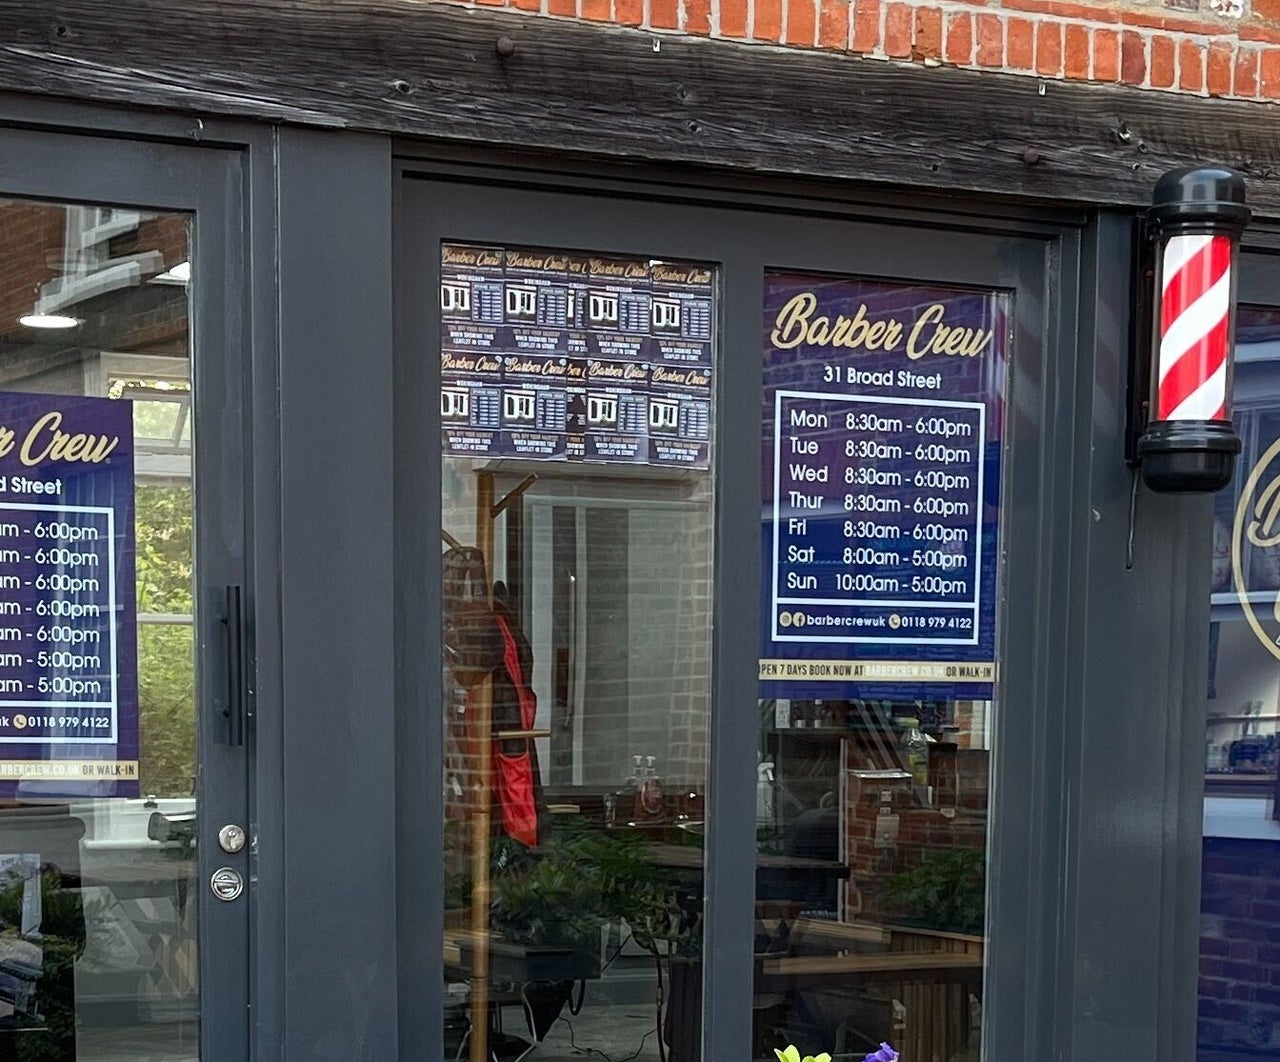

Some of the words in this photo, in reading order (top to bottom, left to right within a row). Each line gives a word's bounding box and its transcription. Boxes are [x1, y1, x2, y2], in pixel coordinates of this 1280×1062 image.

[770, 292, 903, 351] Barber
[906, 304, 993, 360] Crew
[823, 366, 841, 383] 31
[847, 367, 894, 386] Broad
[897, 371, 941, 389] Street
[790, 409, 828, 428] Mon
[846, 413, 903, 432] 8:30am
[915, 417, 971, 438] 6:00pm
[20, 411, 119, 466] Crew
[790, 437, 819, 455] Tue
[845, 440, 902, 459] 8:30am
[914, 444, 970, 465] 6:00pm
[11, 477, 62, 495] Street
[789, 464, 828, 482] Wed
[844, 467, 901, 486] 8:30am
[914, 471, 970, 491] 6:00pm
[789, 491, 824, 509] Thur
[844, 494, 900, 512] 8:30am
[913, 497, 968, 517] 6:00pm
[34, 522, 98, 543] 6:00pm
[789, 518, 806, 536] Fri
[843, 521, 900, 539] 8:30am
[913, 524, 968, 544] 6:00pm
[34, 548, 99, 568] 6:00pm
[788, 545, 815, 563] Sat
[843, 548, 899, 566] 8:00am
[912, 550, 967, 570] 5:00pm
[35, 574, 99, 595] 6:00pm
[787, 572, 817, 590] Sun
[836, 574, 899, 592] 10:00am
[911, 577, 966, 596] 5:00pm
[36, 600, 100, 620] 6:00pm
[807, 615, 885, 627] barbercrewuk
[902, 616, 926, 627] 0118
[928, 617, 946, 628] 979
[948, 617, 971, 629] 4122
[36, 626, 100, 645] 6:00pm
[37, 651, 100, 671] 5:00pm
[760, 664, 777, 675] PEN
[780, 664, 785, 675] 7
[787, 664, 807, 675] DAYS
[809, 665, 831, 675] BOOK
[833, 665, 852, 676] NOW
[854, 666, 863, 676] AT
[946, 667, 957, 676] OR
[959, 667, 991, 677] WALK-IN
[37, 677, 101, 696] 5:00pm
[28, 716, 56, 727] 0118
[58, 717, 79, 727] 979
[82, 717, 109, 728] 4122
[82, 764, 94, 775] OR
[97, 764, 135, 776] WALK-IN
